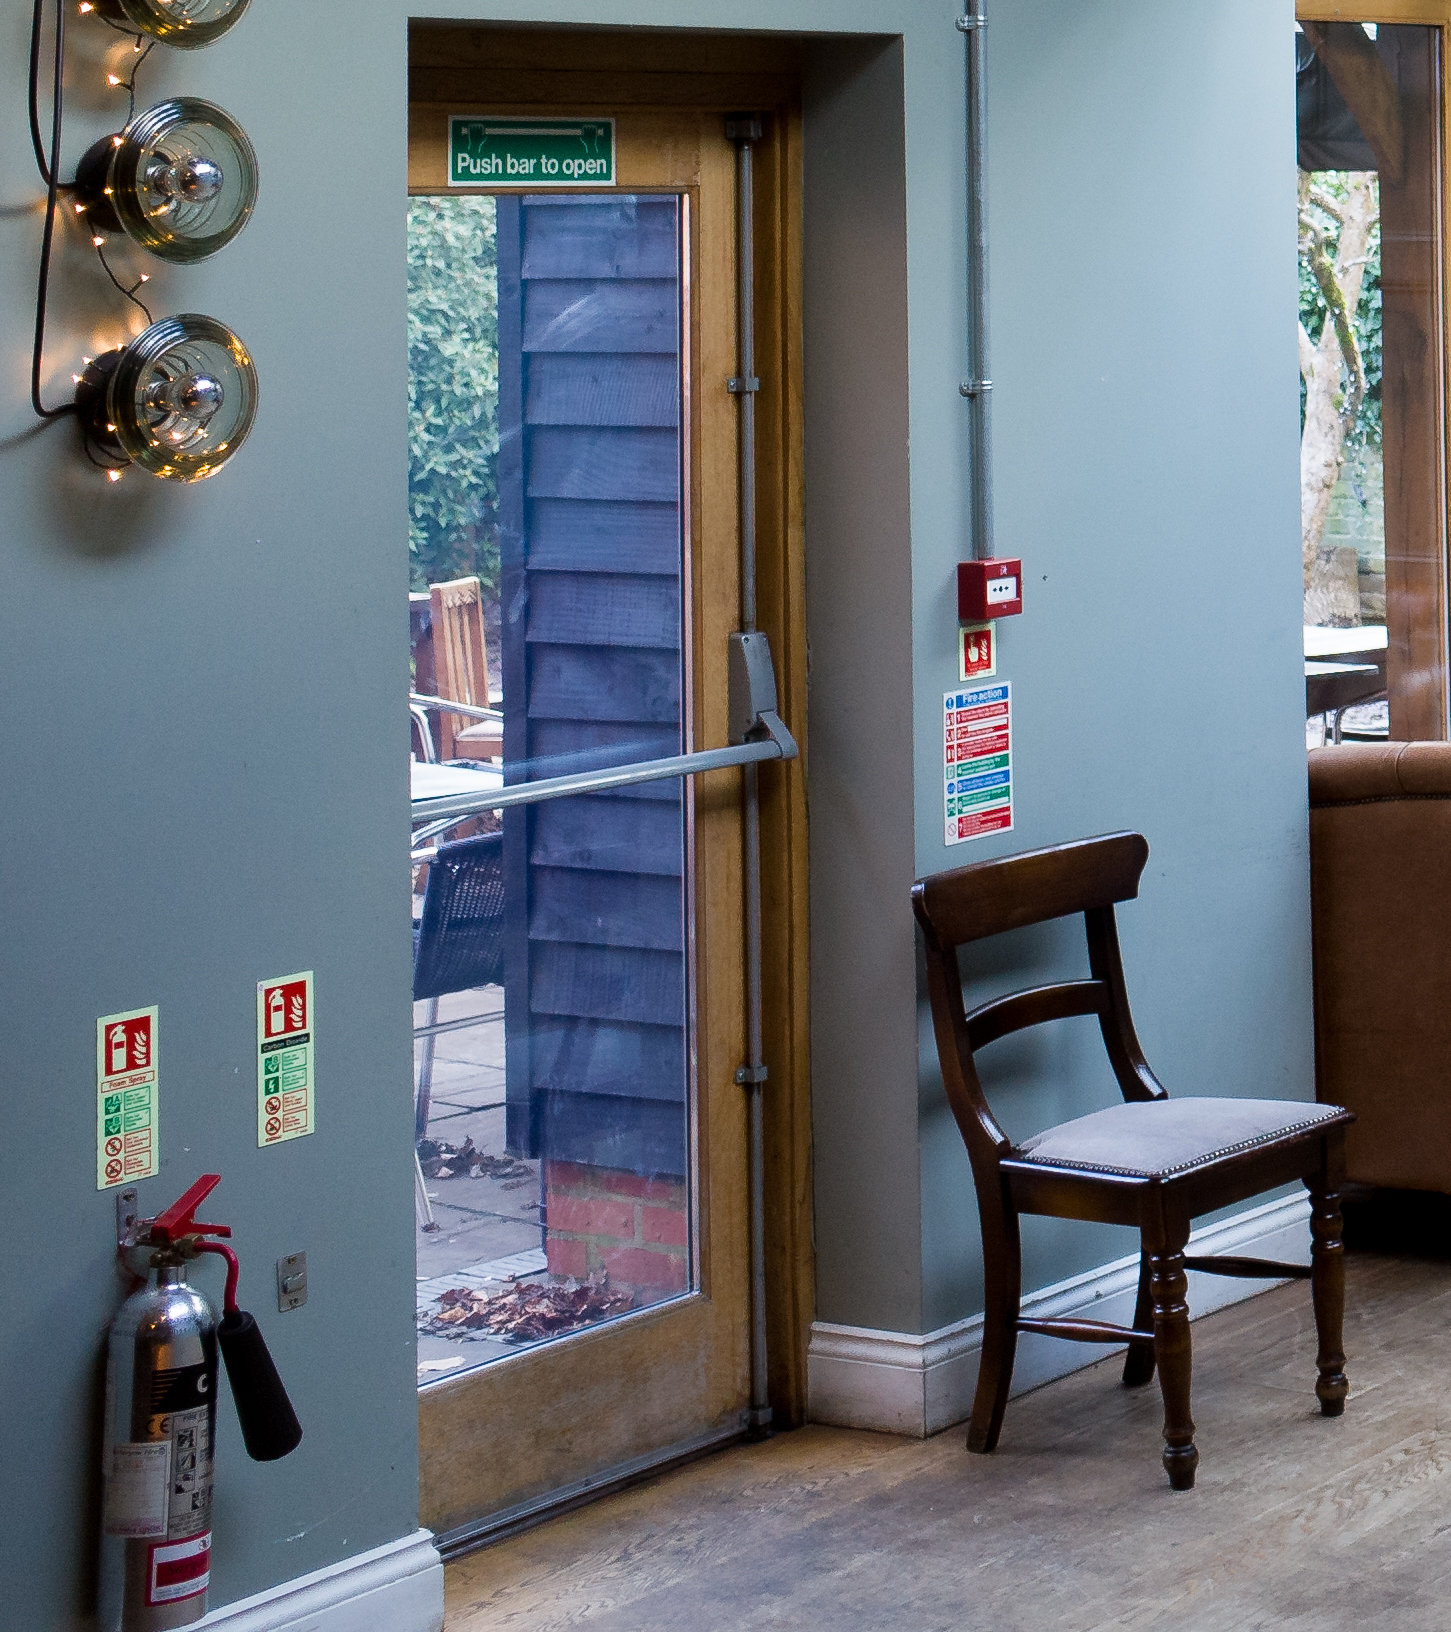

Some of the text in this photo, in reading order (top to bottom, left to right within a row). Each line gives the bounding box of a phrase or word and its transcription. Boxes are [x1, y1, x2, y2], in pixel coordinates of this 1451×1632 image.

[457, 153, 607, 178] Push bar to open
[962, 692, 977, 704] Fire
[979, 688, 1003, 701] action
[263, 1035, 308, 1052] Carbon Dioxide
[108, 1075, 147, 1089] Foam Spray
